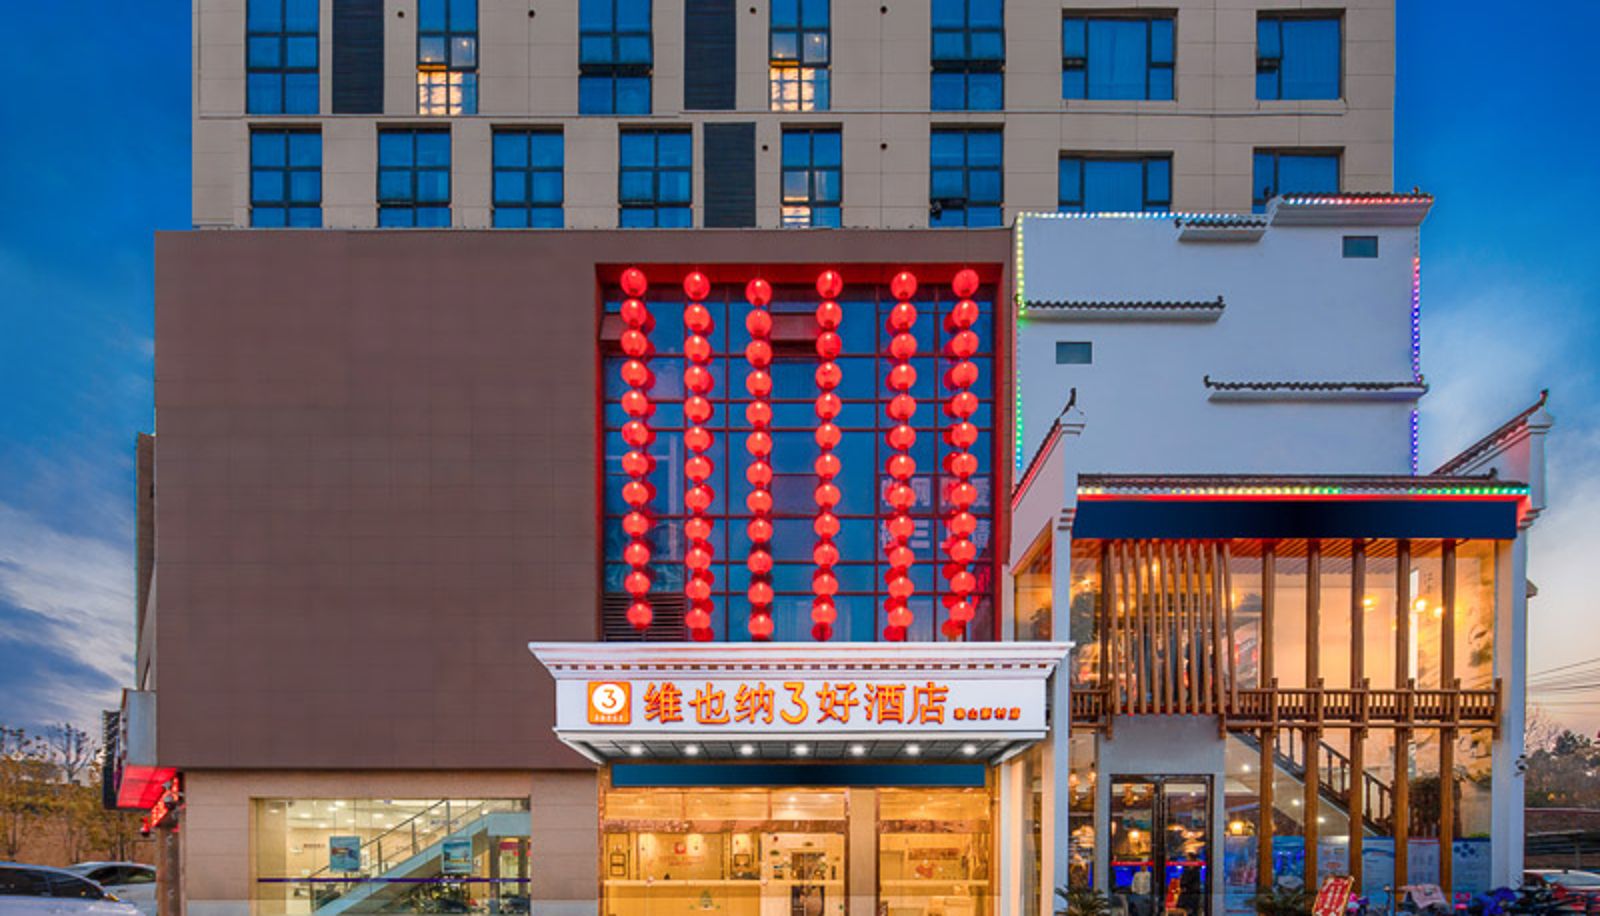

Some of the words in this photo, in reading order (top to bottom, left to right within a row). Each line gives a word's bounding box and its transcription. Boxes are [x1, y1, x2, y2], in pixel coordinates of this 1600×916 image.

[601, 689, 617, 709] 3
[643, 681, 950, 726] 维也纳3好酒店
